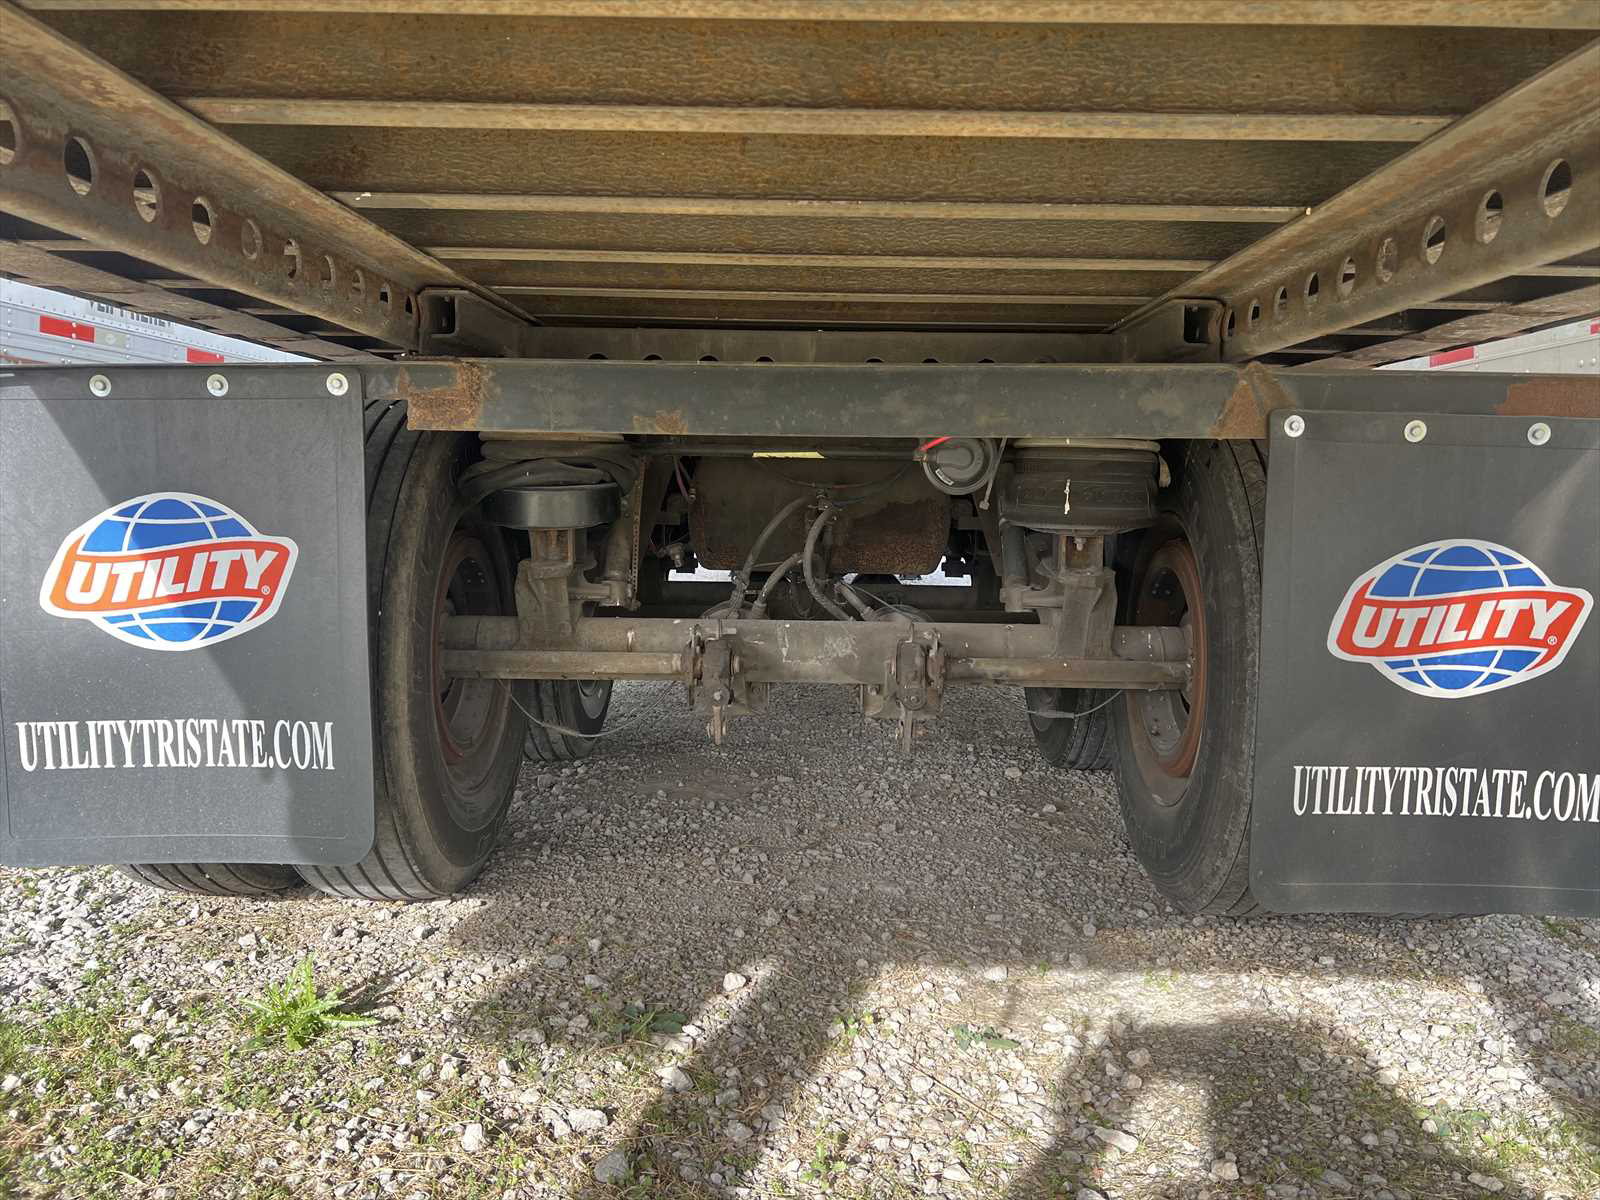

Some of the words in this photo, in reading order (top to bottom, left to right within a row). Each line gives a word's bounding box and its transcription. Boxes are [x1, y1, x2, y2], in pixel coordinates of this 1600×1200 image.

[65, 549, 279, 604] UTILITY
[1352, 598, 1572, 648] UTILITY
[16, 719, 336, 771] UTILITYTRISTATE.COM
[1293, 765, 1600, 822] UTILITYTRISTATE.COM
